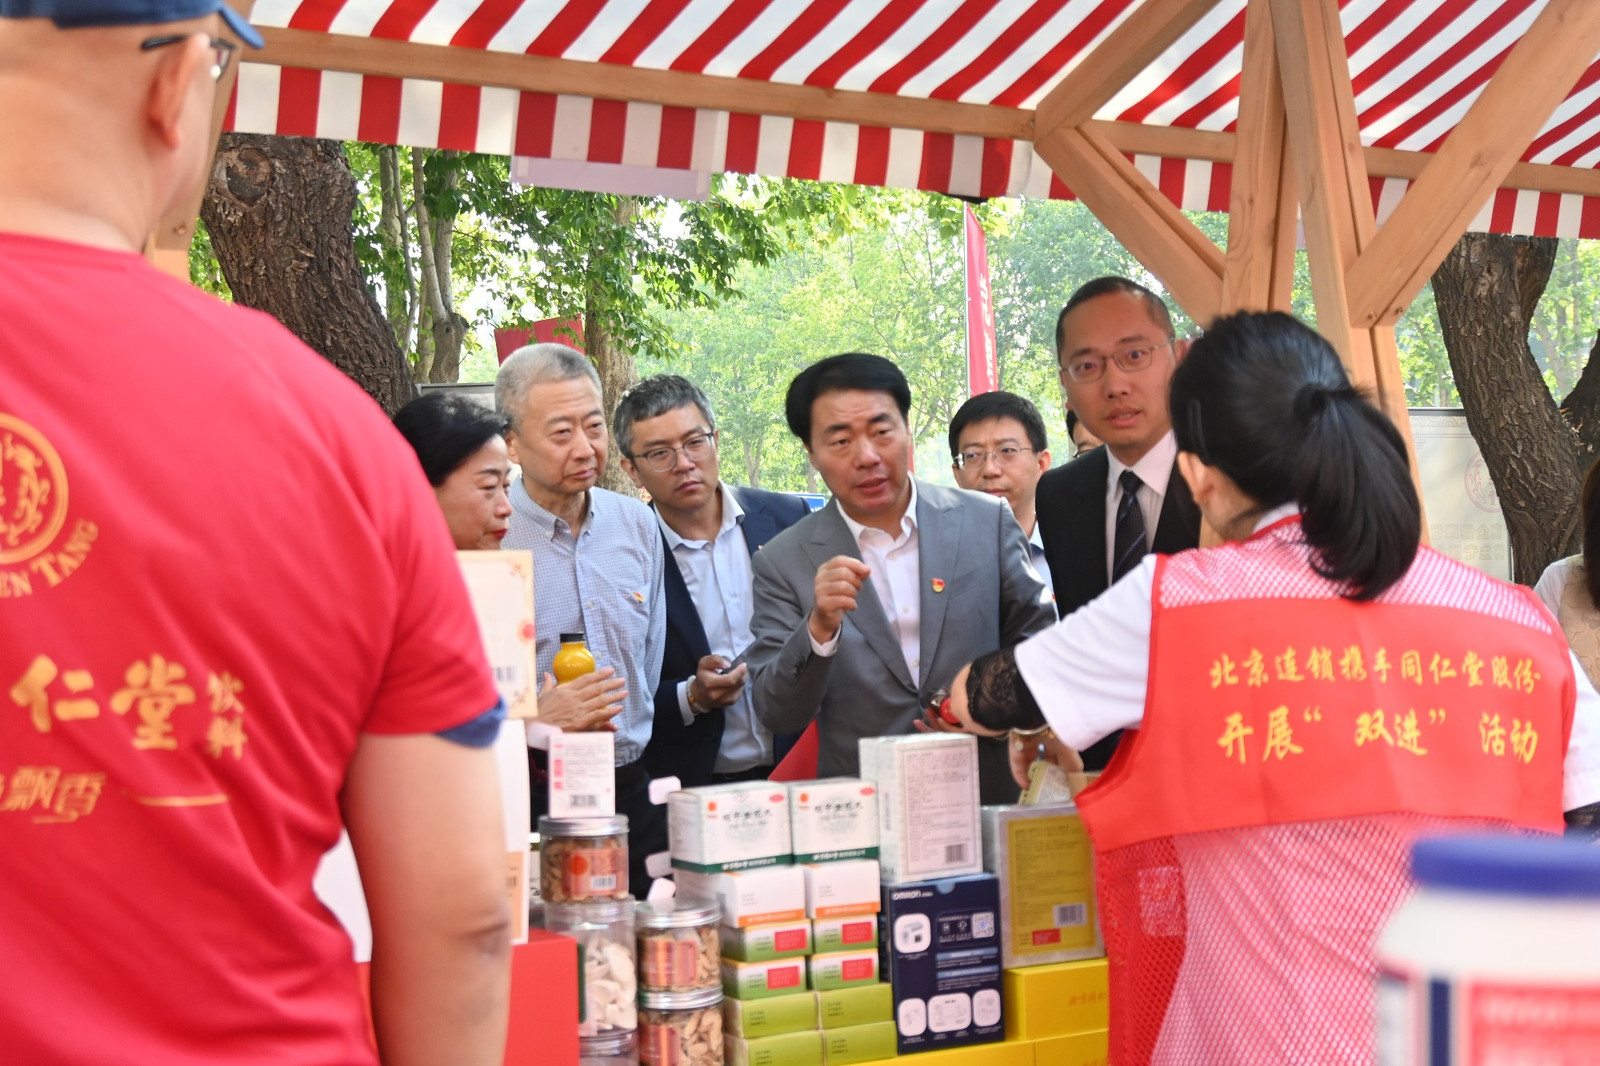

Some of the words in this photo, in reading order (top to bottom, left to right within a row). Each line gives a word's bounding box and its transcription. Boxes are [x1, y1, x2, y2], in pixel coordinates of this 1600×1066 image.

[1209, 645, 1541, 694] 北京连锁携手同仁堂股份
[10, 653, 196, 750] 仁堂
[1479, 711, 1539, 764] 活动
[0, 766, 106, 824] 飘香
